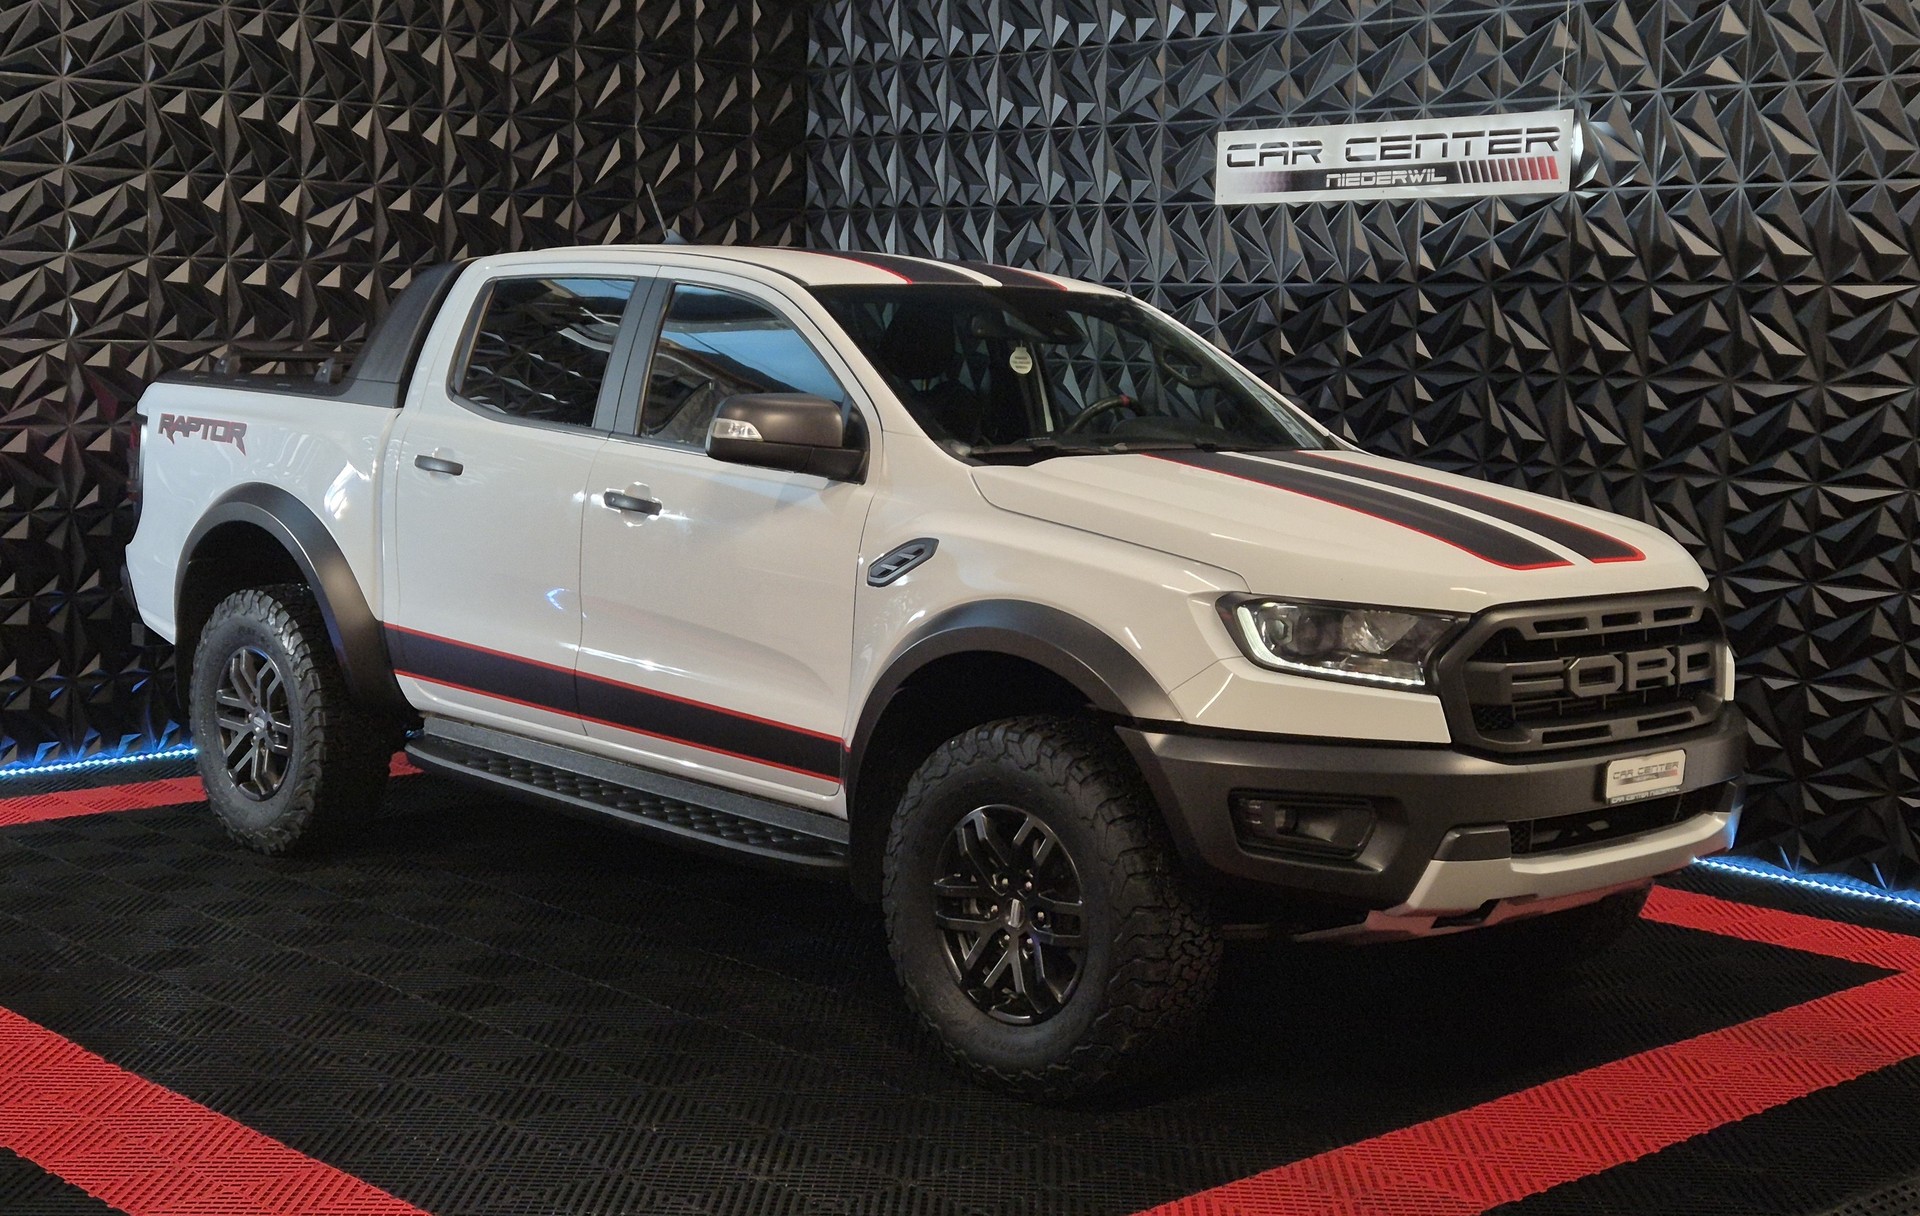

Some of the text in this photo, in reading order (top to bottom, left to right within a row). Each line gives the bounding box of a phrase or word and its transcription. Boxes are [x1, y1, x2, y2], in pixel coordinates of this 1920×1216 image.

[1226, 126, 1561, 168] CAR CENTER
[1326, 167, 1448, 188] NIEDERWIL
[158, 413, 247, 456] RAPTOR
[1469, 643, 1716, 705] FORD
[1613, 769, 1633, 780] CAR
